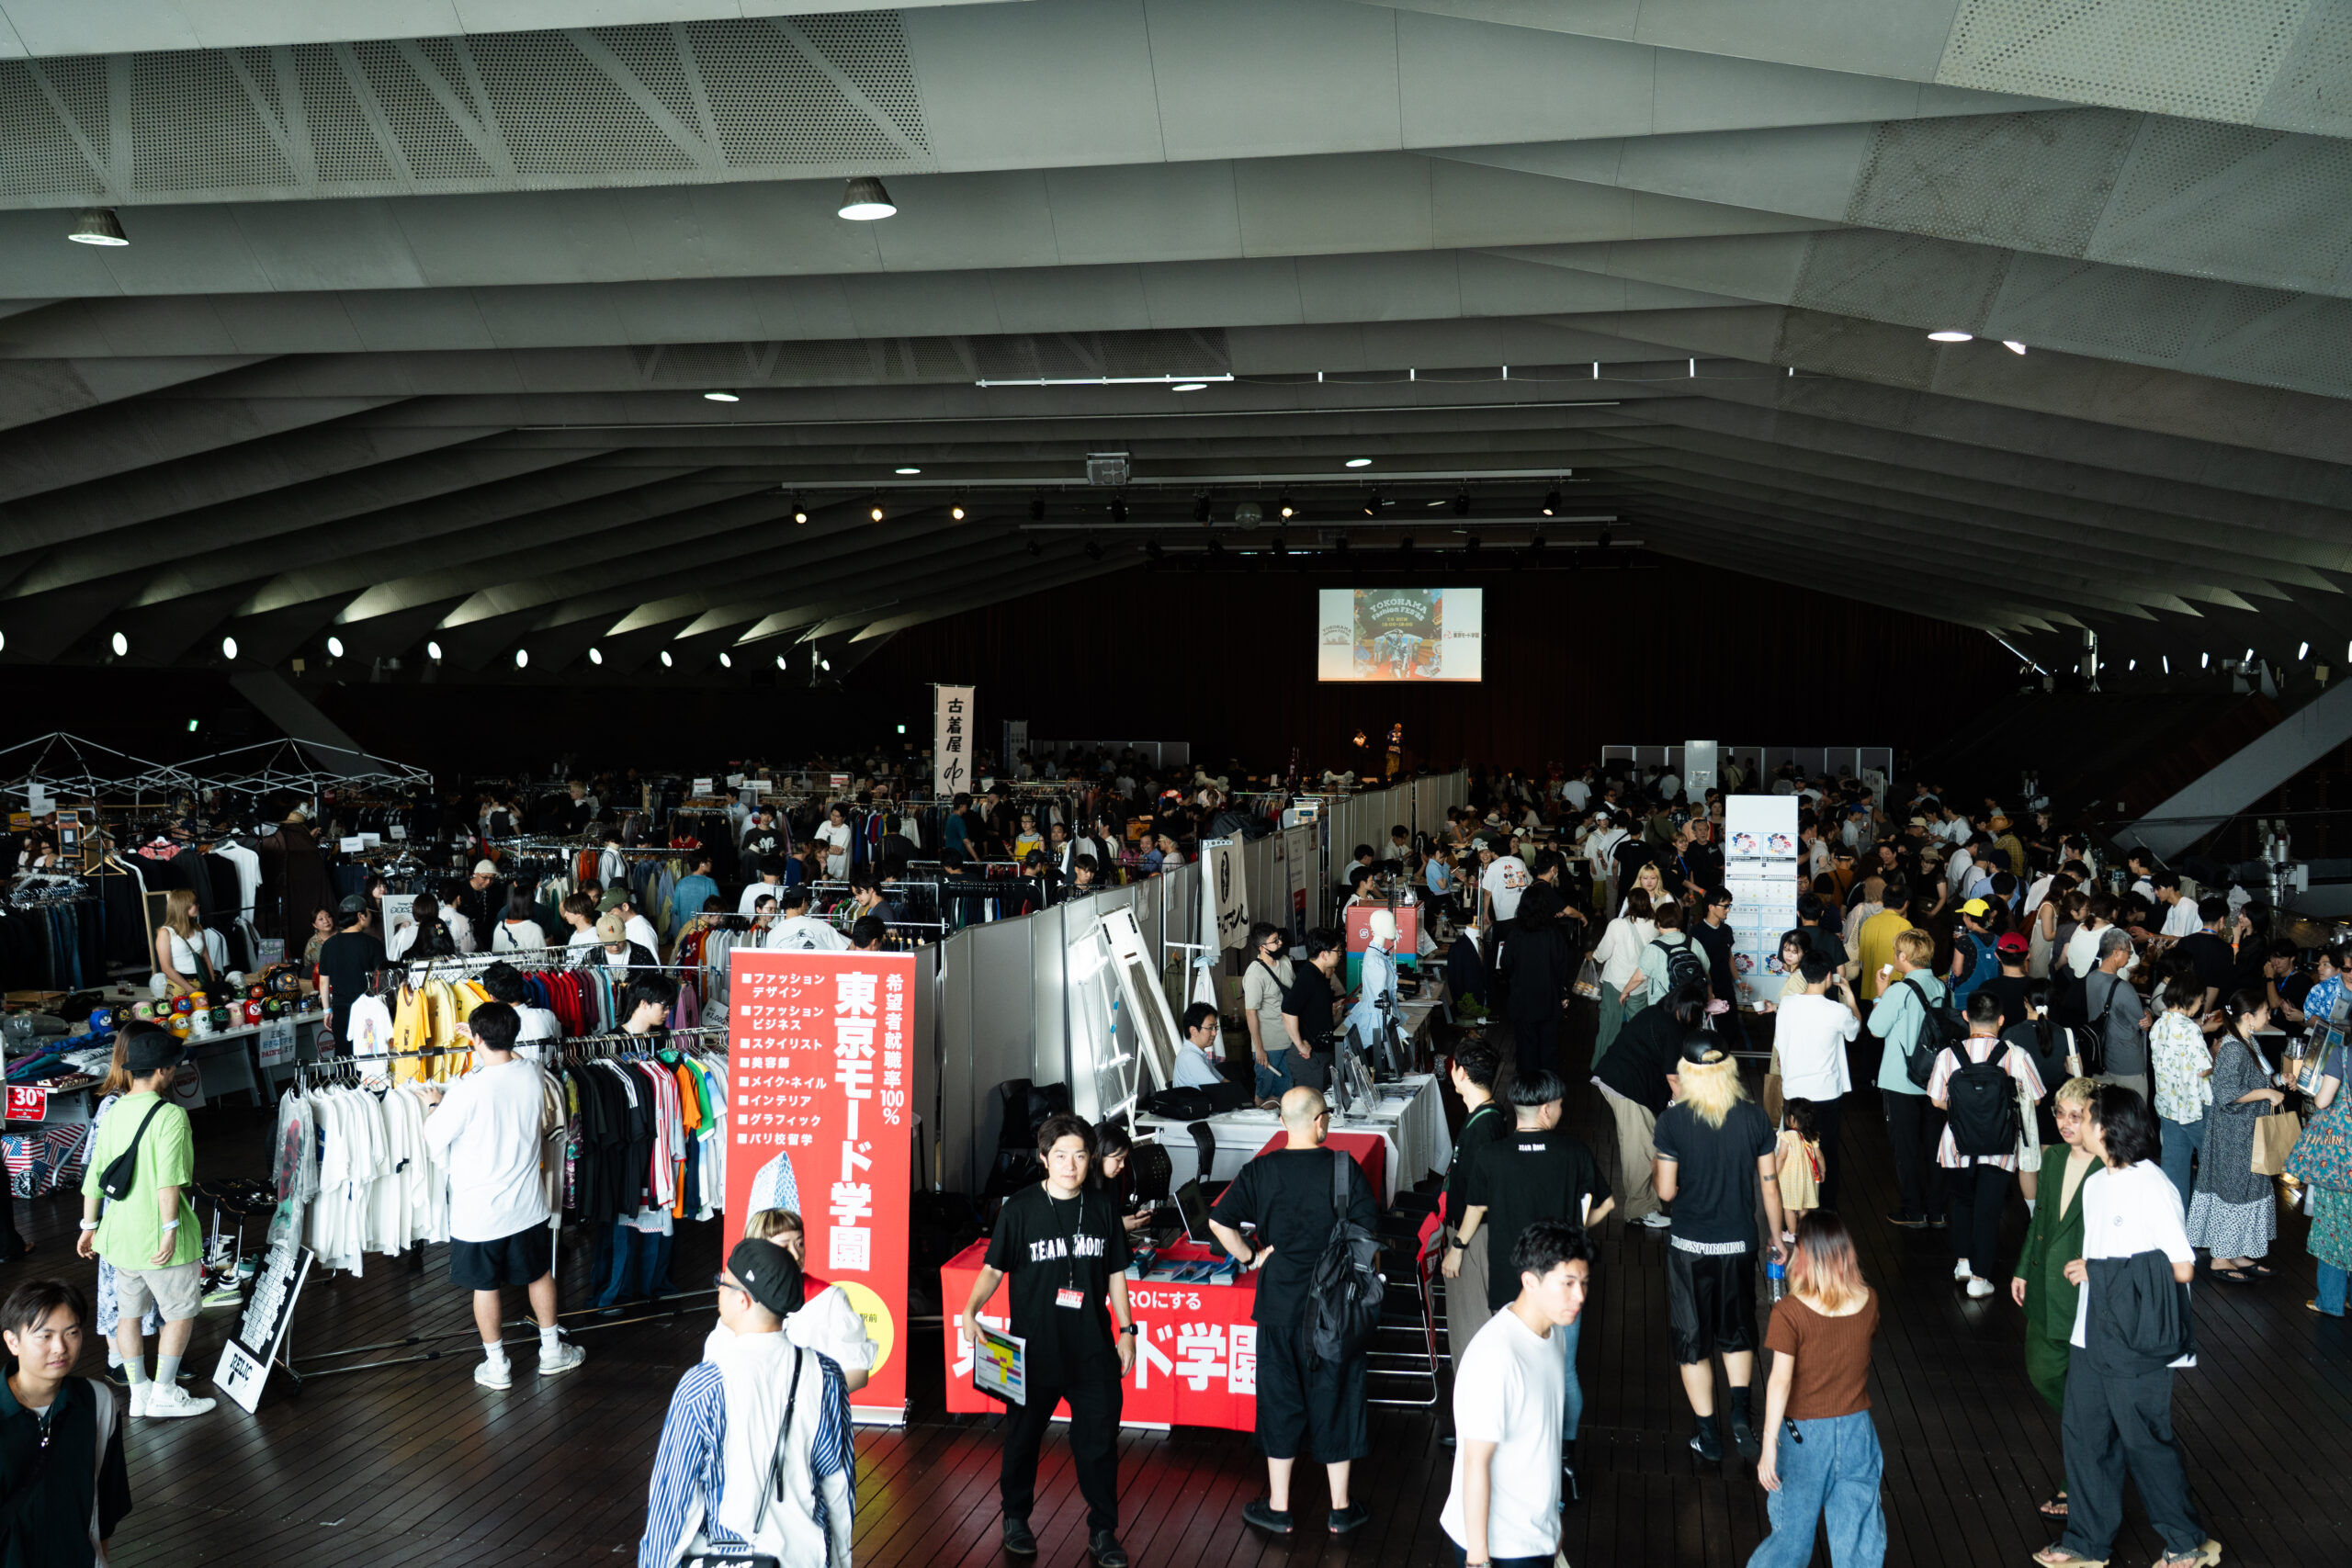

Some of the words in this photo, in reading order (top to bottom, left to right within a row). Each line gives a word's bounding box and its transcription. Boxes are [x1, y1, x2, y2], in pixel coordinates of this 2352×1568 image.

[1370, 598, 1428, 614] YOKOHAMA
[1372, 607, 1399, 621] Fashion
[752, 972, 825, 986] ファッション
[752, 987, 802, 998] デザイン
[752, 1005, 824, 1018] ファッション
[752, 1019, 802, 1031] ビジネス
[752, 1038, 823, 1051] スタイリスト
[752, 1057, 790, 1069] 美容師
[751, 1095, 811, 1107] インテリア
[750, 1112, 821, 1127] グラフィック
[829, 971, 878, 1272] 東京モード学園
[749, 1134, 813, 1146] パリ校留学
[1029, 1237, 1068, 1263] TEAM
[1670, 1234, 1747, 1256] TRANSFORMING
[229, 1351, 254, 1382] RELIC
